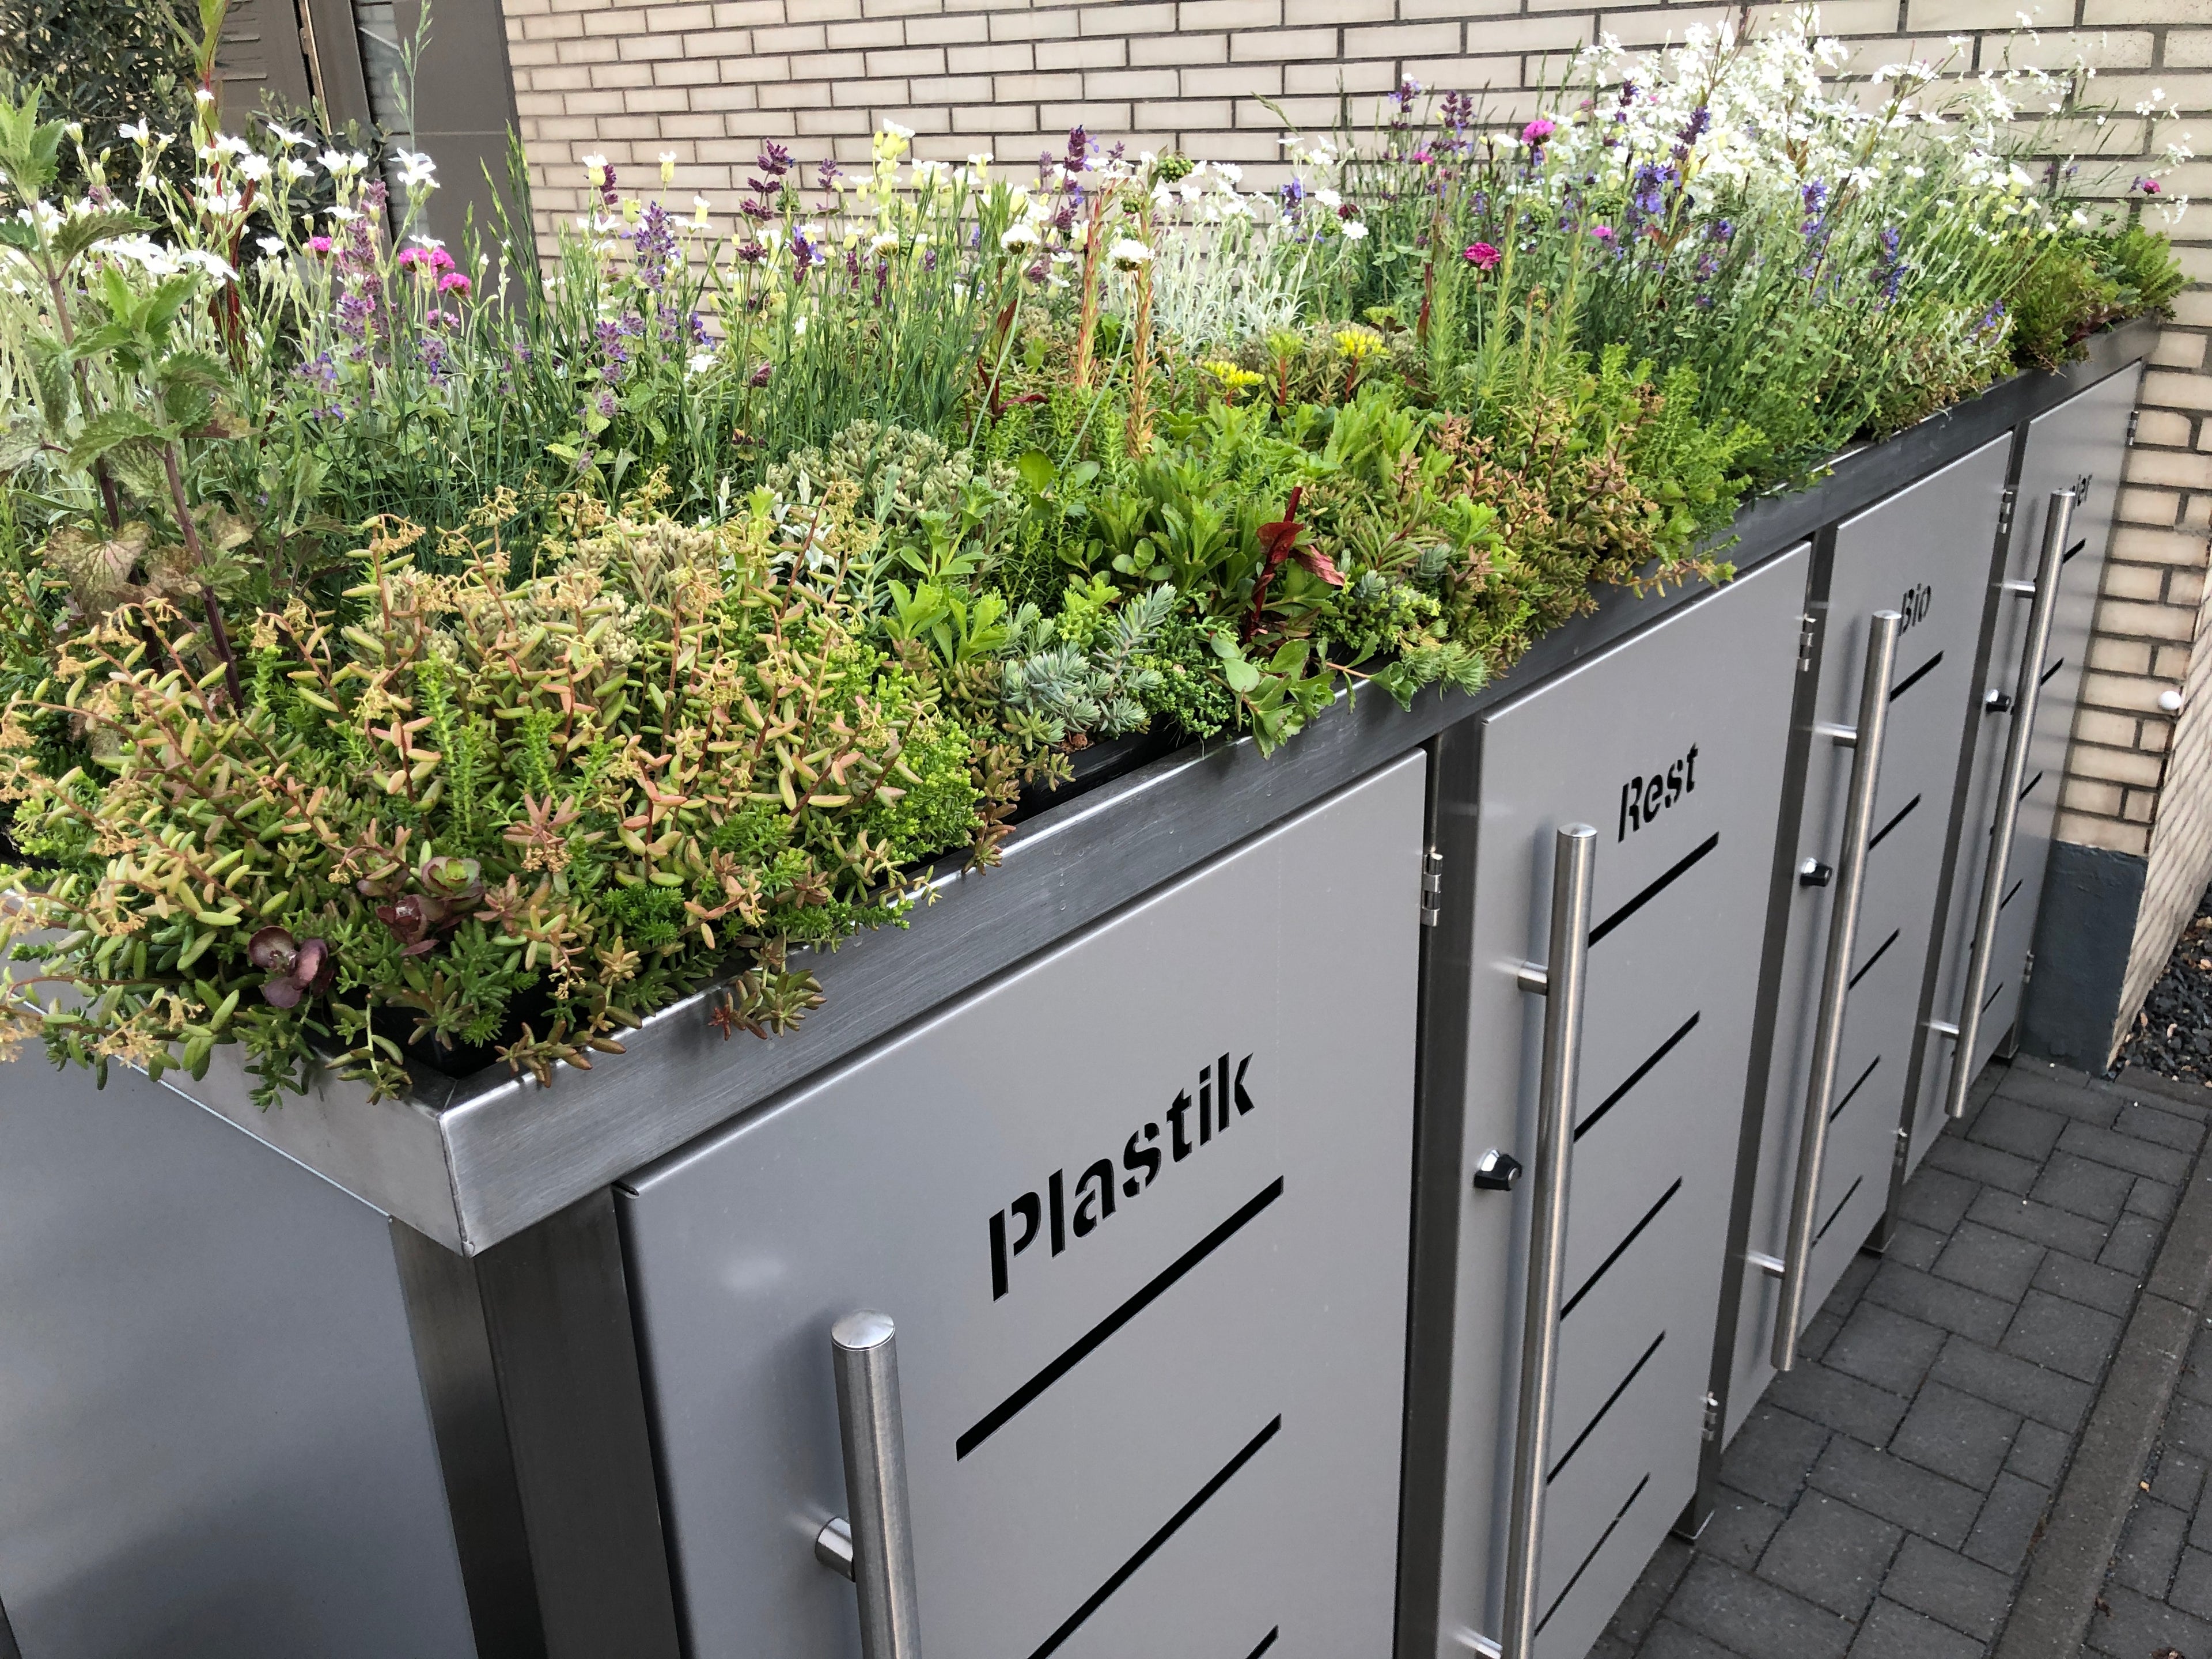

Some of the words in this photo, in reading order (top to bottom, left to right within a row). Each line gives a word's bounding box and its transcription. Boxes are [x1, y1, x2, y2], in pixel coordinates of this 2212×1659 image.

[1899, 583, 1931, 636] Bio
[1618, 742, 1698, 843] Rest
[989, 1052, 1255, 1303] Plastik
